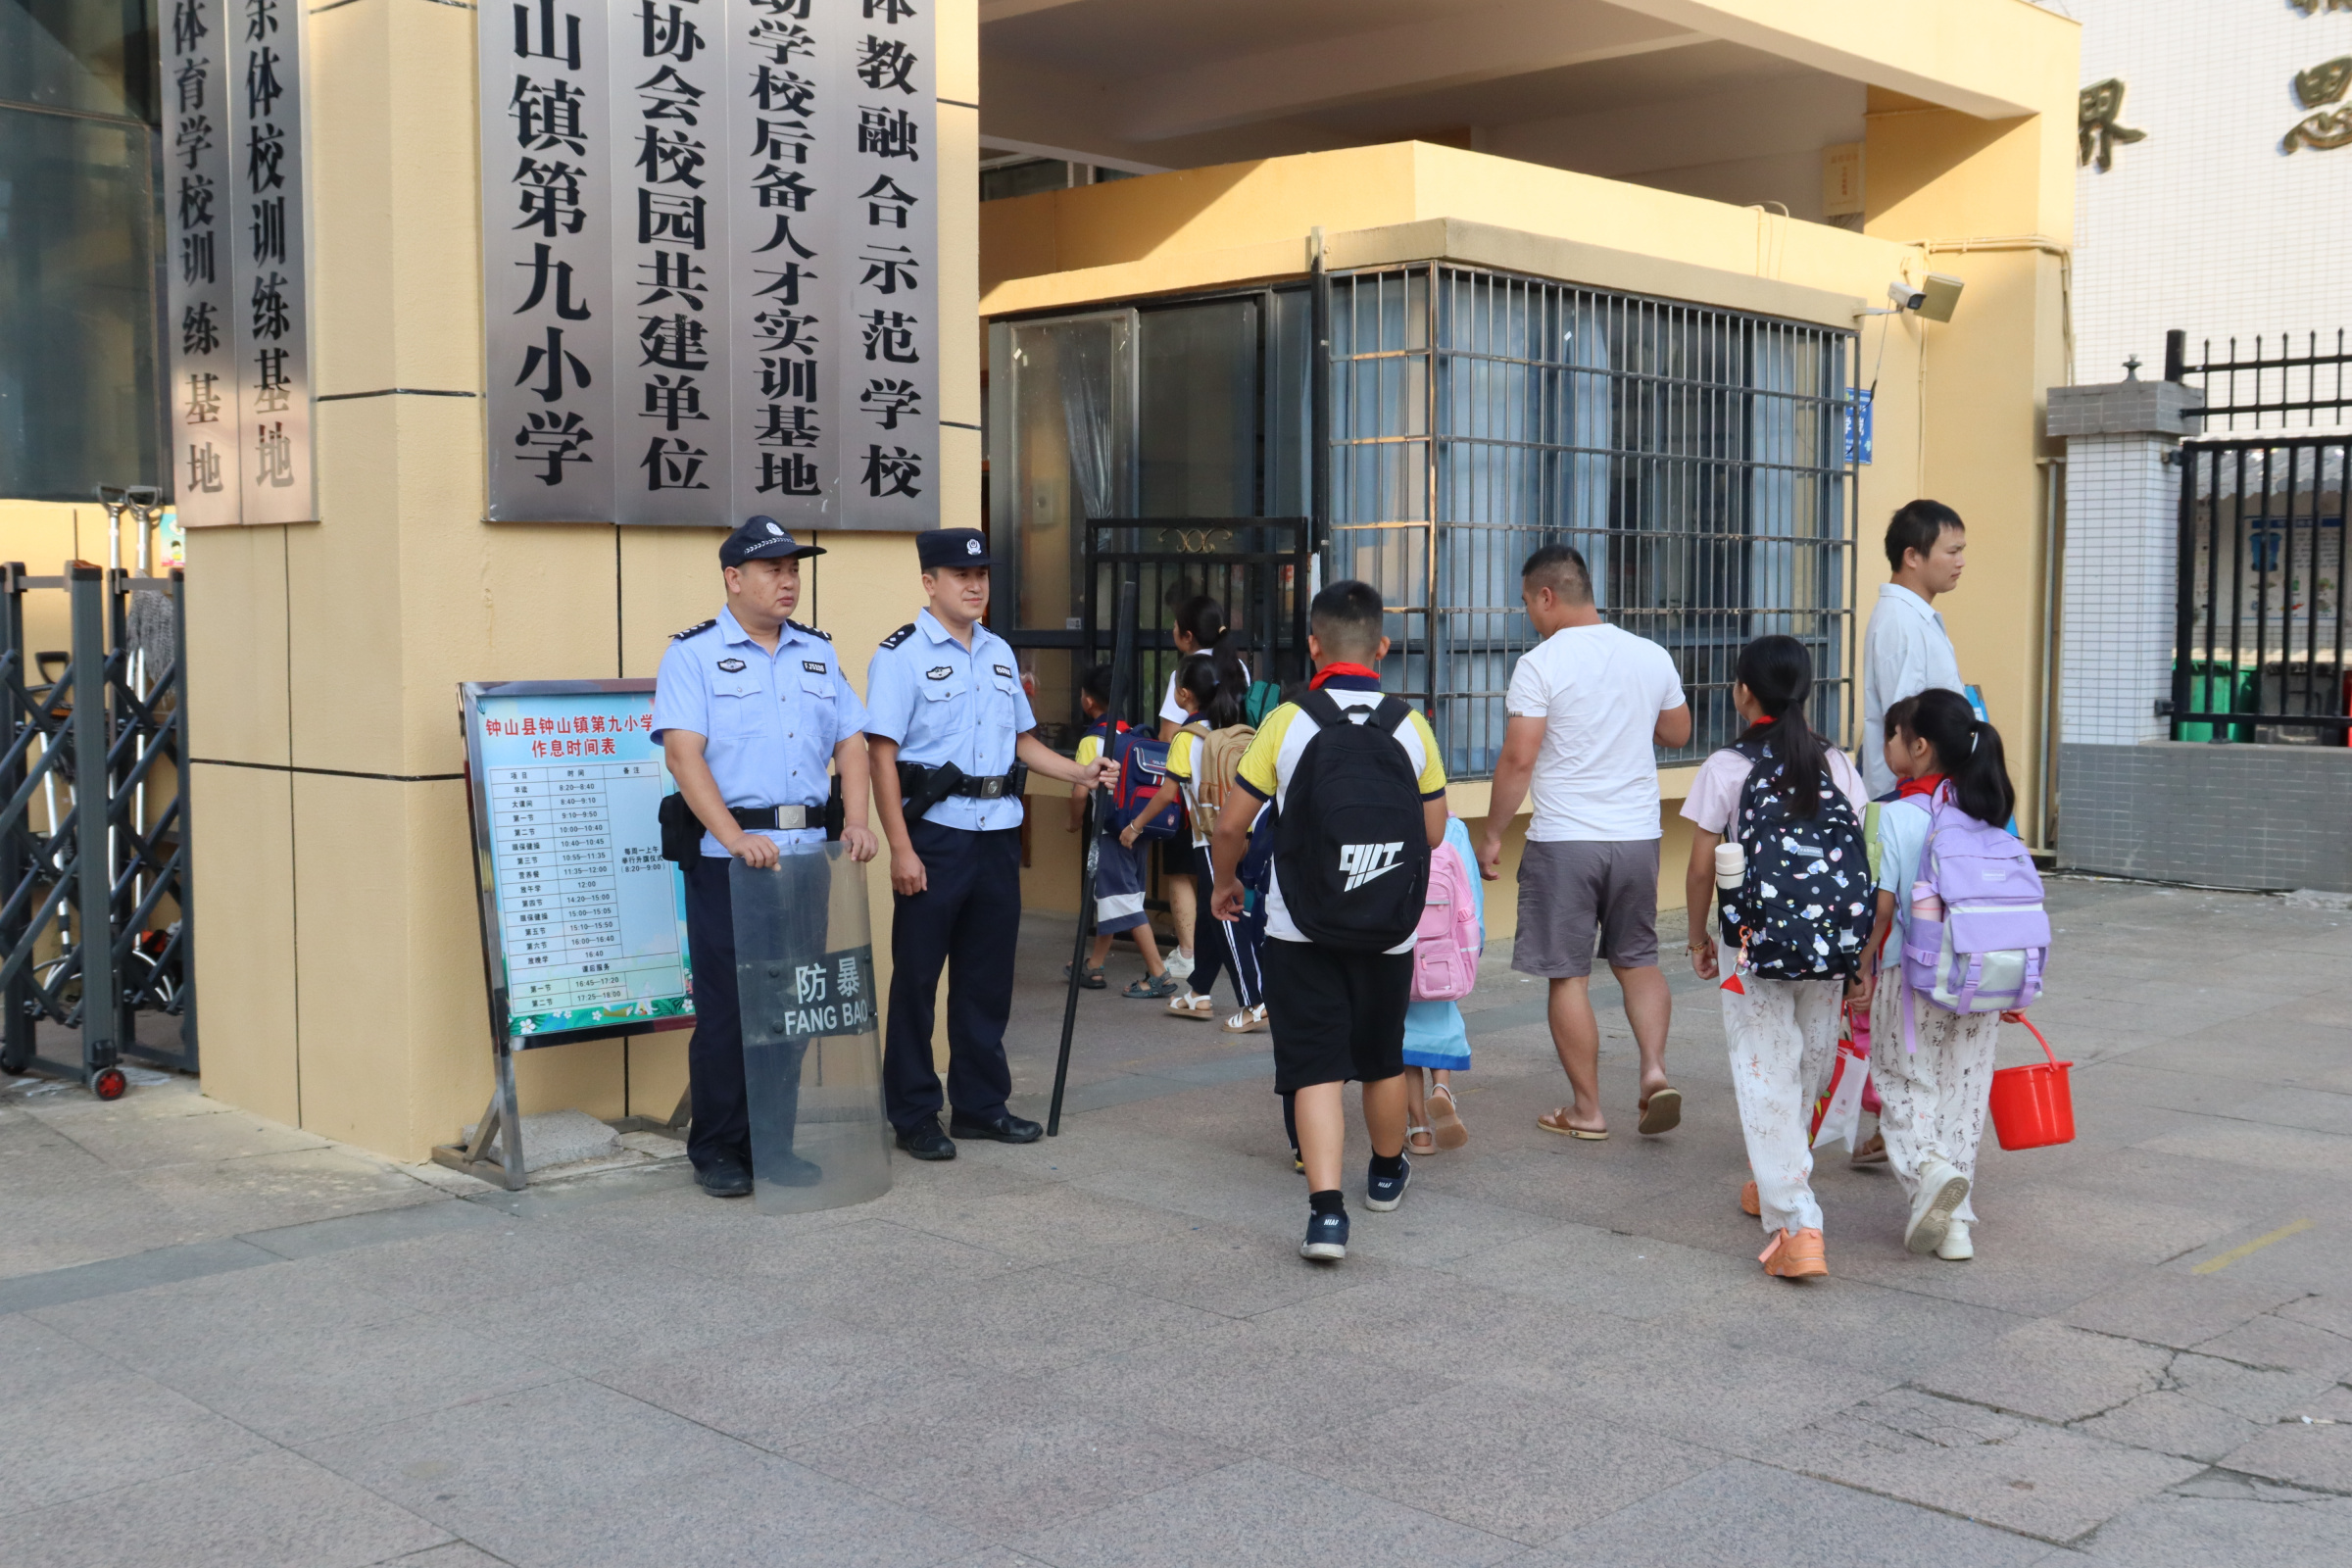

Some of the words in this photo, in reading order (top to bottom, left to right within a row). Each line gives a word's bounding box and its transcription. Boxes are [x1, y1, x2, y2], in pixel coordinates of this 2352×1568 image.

[509, 0, 594, 487] 山镇第九小学
[485, 713, 653, 737] 钟山县钟山镇第九小学
[531, 737, 616, 759] 作息时间表
[795, 956, 860, 1004] 防暴
[784, 1005, 838, 1036] FANG
[842, 999, 868, 1027] BAO
